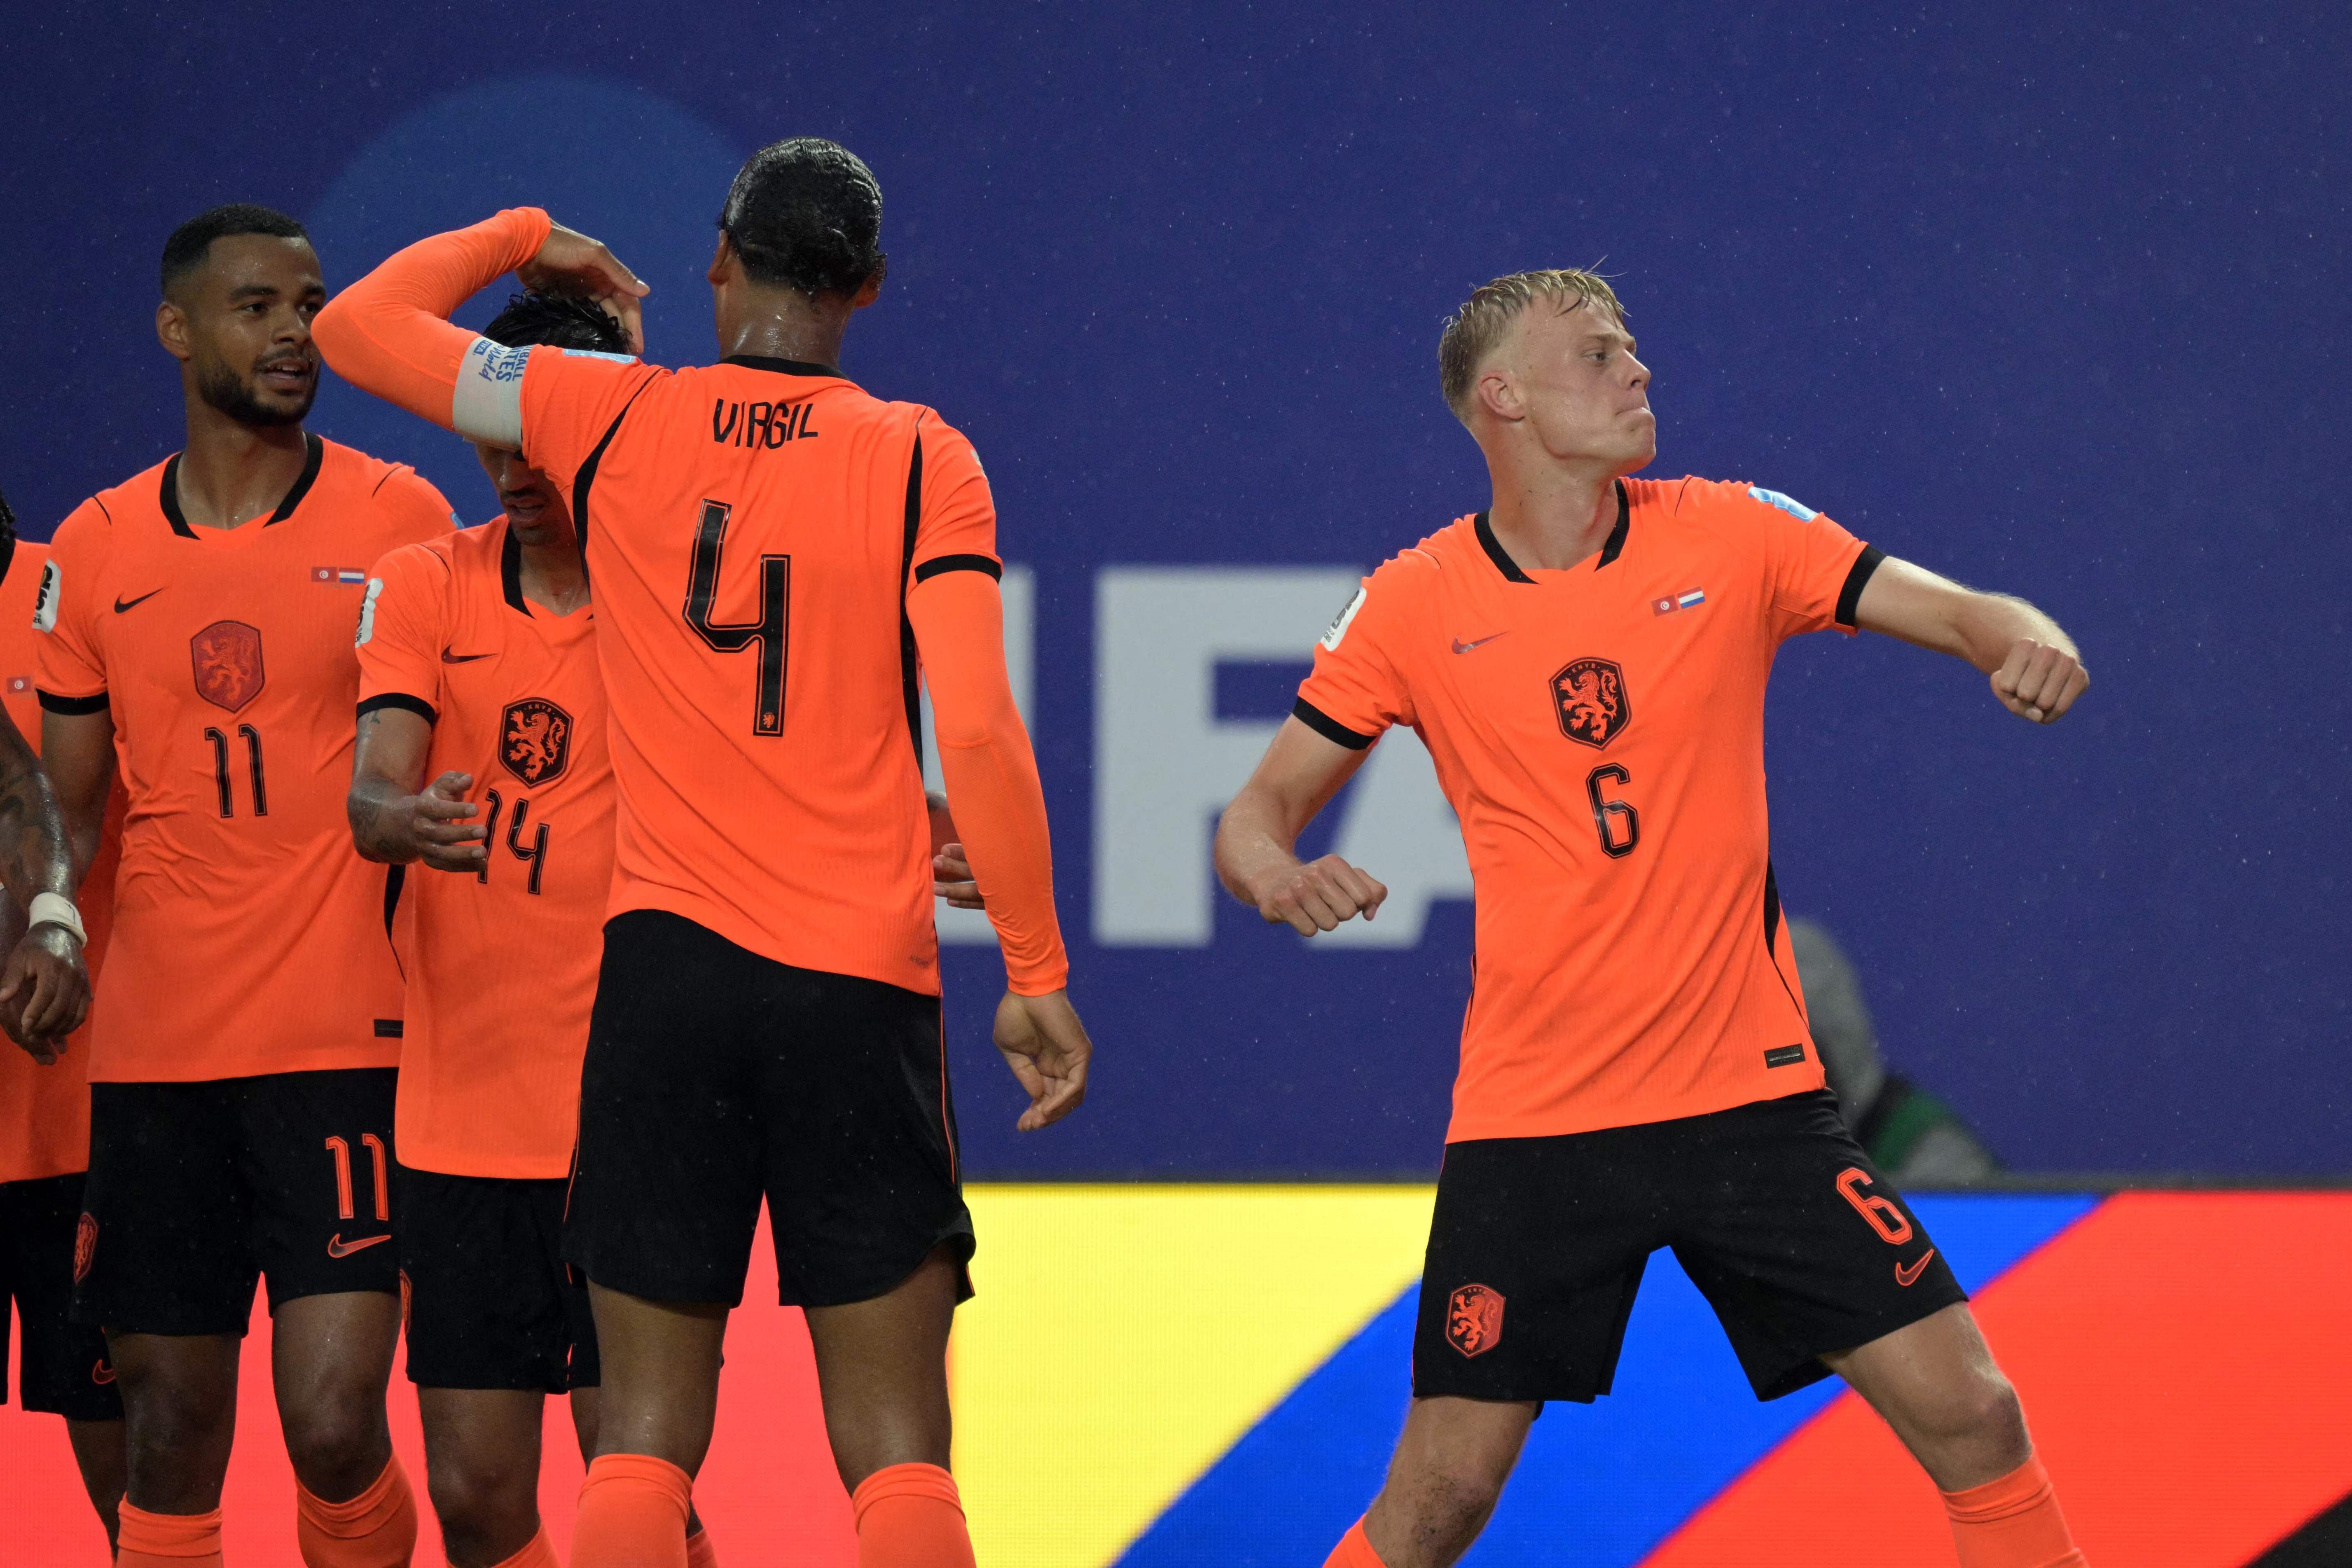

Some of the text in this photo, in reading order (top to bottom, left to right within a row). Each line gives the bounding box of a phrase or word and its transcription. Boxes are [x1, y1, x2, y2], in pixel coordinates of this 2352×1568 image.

[713, 398, 818, 449] VIRGIL
[682, 498, 790, 736] 4
[528, 704, 551, 713] KNVB
[1571, 663, 1596, 673] KNVB
[204, 723, 267, 818] 11
[1586, 762, 1639, 859] 6
[477, 788, 550, 895] 14
[325, 1133, 388, 1221] 11
[1836, 1167, 1912, 1245] 6
